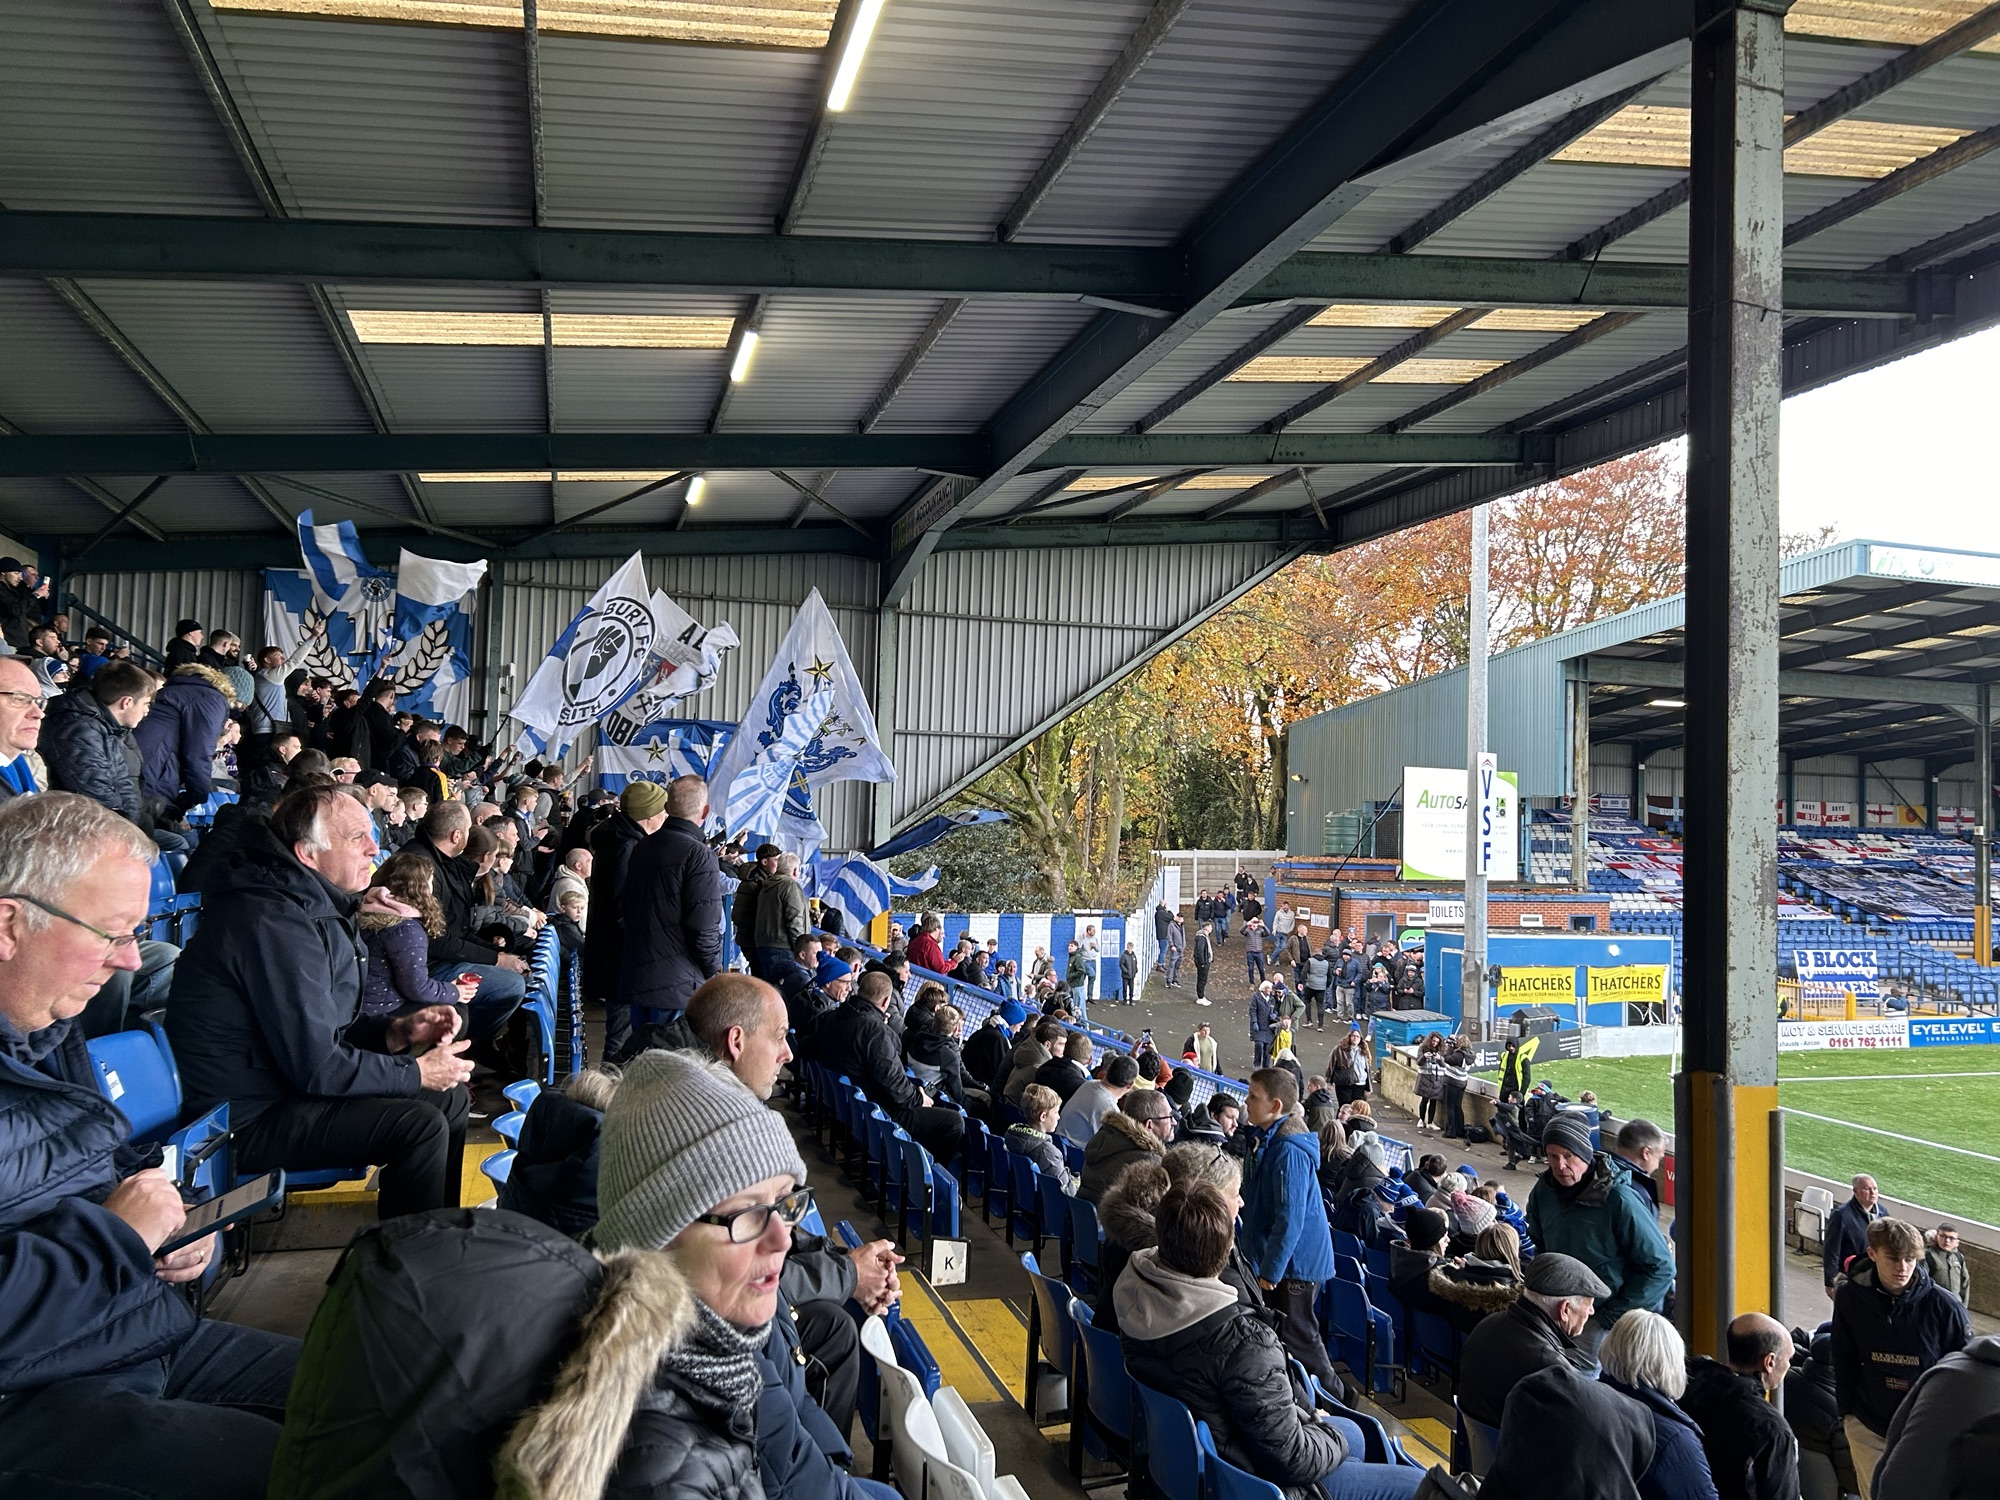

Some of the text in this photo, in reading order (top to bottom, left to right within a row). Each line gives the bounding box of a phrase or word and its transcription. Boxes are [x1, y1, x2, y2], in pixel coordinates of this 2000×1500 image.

[605, 602, 650, 659] BURY FC
[1659, 807, 1681, 817] BURY
[1805, 813, 1828, 821] BURY
[1431, 905, 1464, 918] TOILETS
[1796, 951, 1877, 968] B BLOCK
[1501, 976, 1572, 992] THATCHERS
[1590, 974, 1661, 991] THATCHERS
[1803, 980, 1880, 995] SHAKERS
[1781, 1022, 1906, 1037] MOT & SERVICE CENTRE
[1912, 1023, 1985, 1036] EYELEVEL
[1829, 1036, 1902, 1047] 0161 762 1111
[944, 1256, 955, 1270] K
